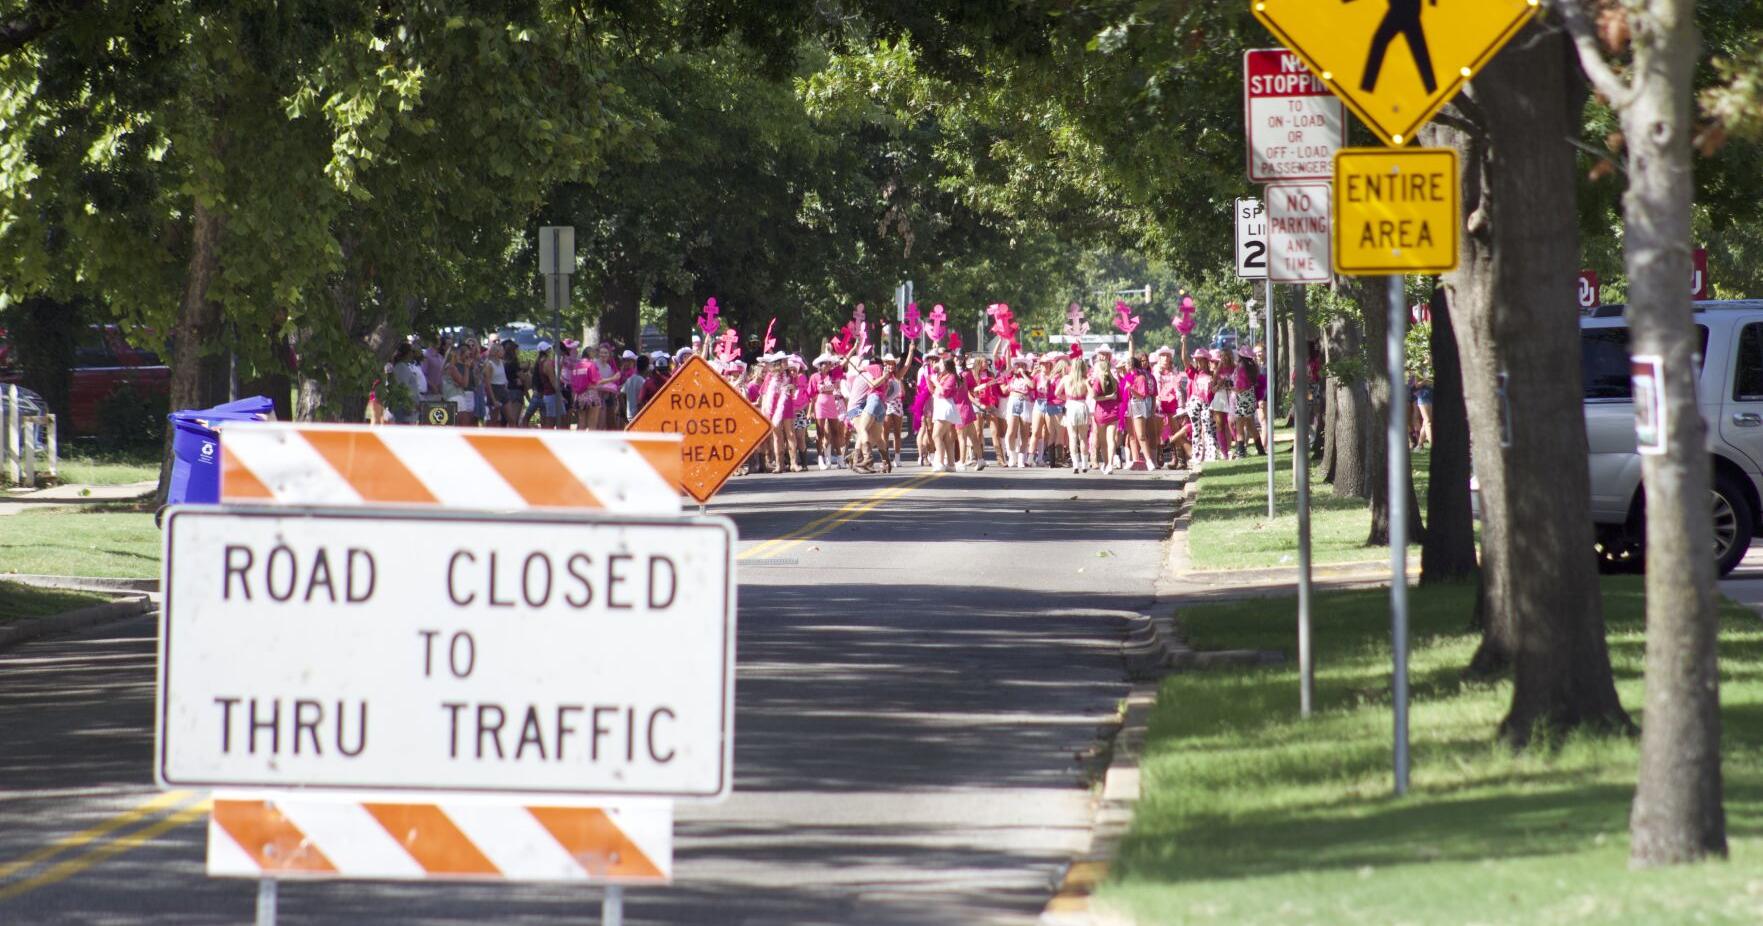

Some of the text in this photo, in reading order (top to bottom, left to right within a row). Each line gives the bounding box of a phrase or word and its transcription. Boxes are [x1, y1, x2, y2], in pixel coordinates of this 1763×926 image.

[1251, 74, 1328, 94] STOPPIN
[1288, 100, 1303, 112] TO
[1288, 131, 1303, 143] OR
[1261, 161, 1335, 174] PASSENGERS
[1346, 173, 1444, 202] ENTIRE
[1286, 194, 1312, 212] NO
[1271, 217, 1327, 234] PARKING
[1359, 220, 1434, 249] AREA
[1243, 240, 1266, 268] 2
[1286, 239, 1312, 253] ANY
[1285, 257, 1314, 271] TIME
[671, 392, 724, 409] ROAD
[661, 418, 737, 434] CLOSED
[682, 445, 734, 461] HEAD
[223, 544, 678, 610] ROAD CLOSED
[418, 630, 476, 678] TO
[214, 697, 677, 763] THRU TRAFFIC
